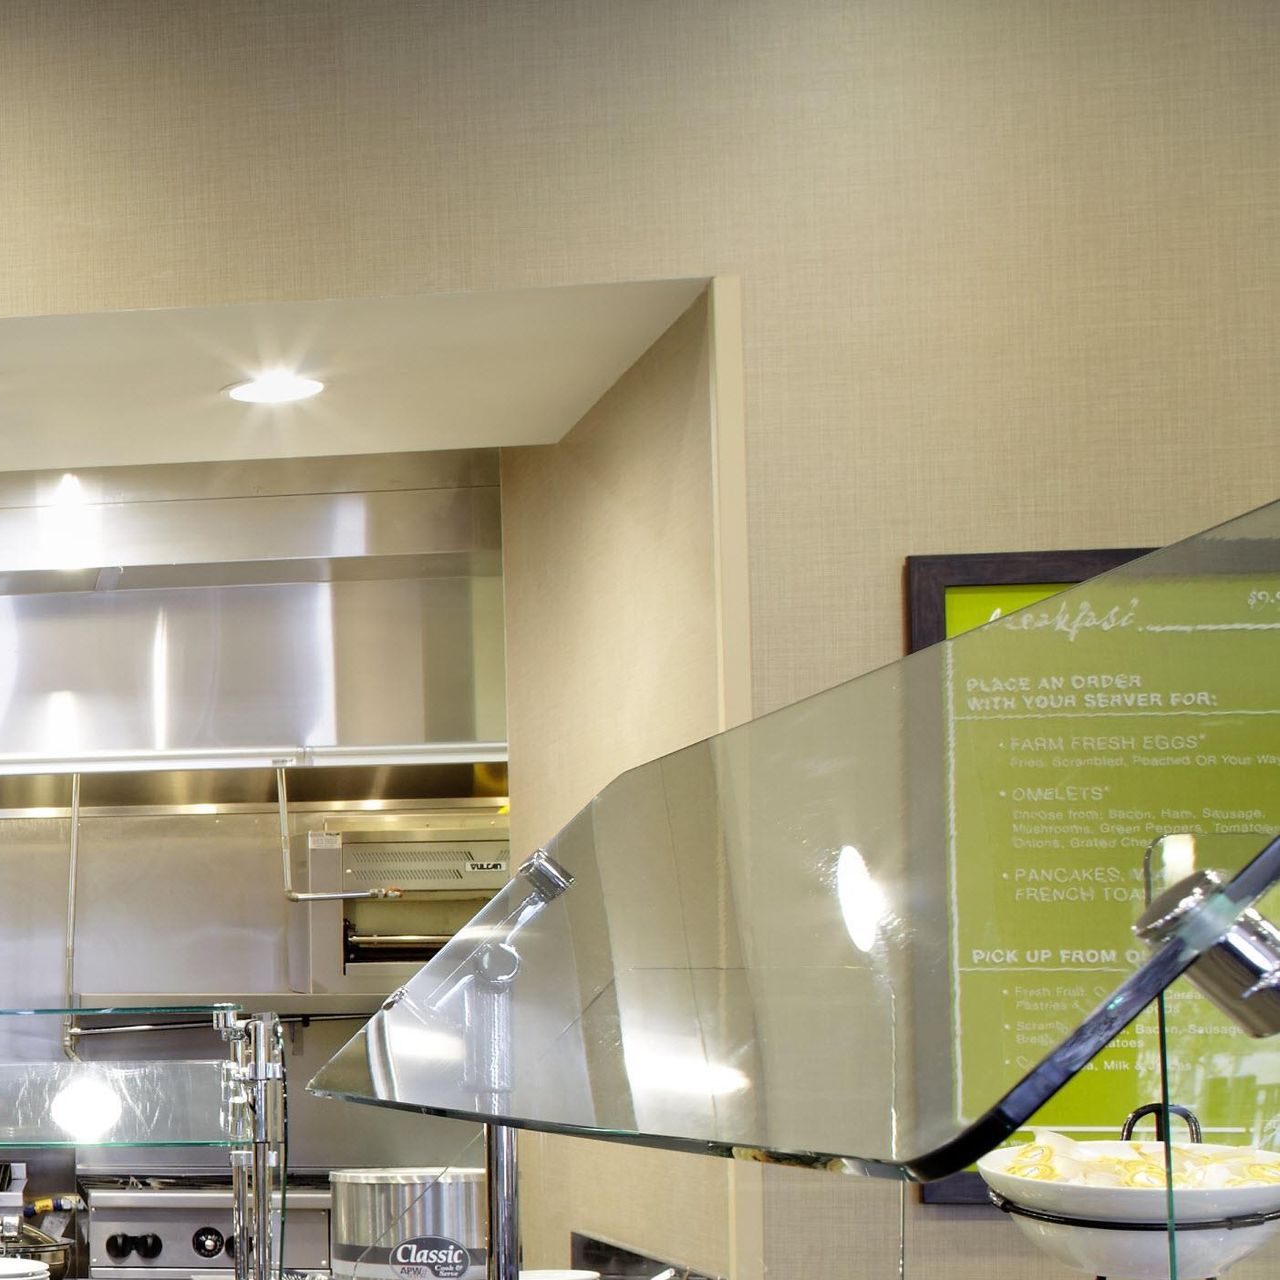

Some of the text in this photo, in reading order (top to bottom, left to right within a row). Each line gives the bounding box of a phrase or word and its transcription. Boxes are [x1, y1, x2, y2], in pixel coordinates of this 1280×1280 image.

[966, 674, 1141, 692] PLACE AN ORDER
[966, 692, 1217, 711] WITH YOUR SERVER FOR:
[1010, 737, 1064, 751] FARM
[1070, 736, 1135, 750] FRESH
[1133, 754, 1190, 766] Poached
[1196, 754, 1217, 765] OR
[1221, 754, 1251, 765] Your
[1100, 823, 1140, 834] Green
[1070, 837, 1116, 848] Grated
[1015, 886, 1142, 902] FRENCH TOA
[972, 950, 1018, 964] PICK
[1026, 950, 1051, 963] UP
[1060, 949, 1117, 964] FROM
[1104, 1061, 1130, 1071] Milk
[397, 1244, 463, 1263] Classic
